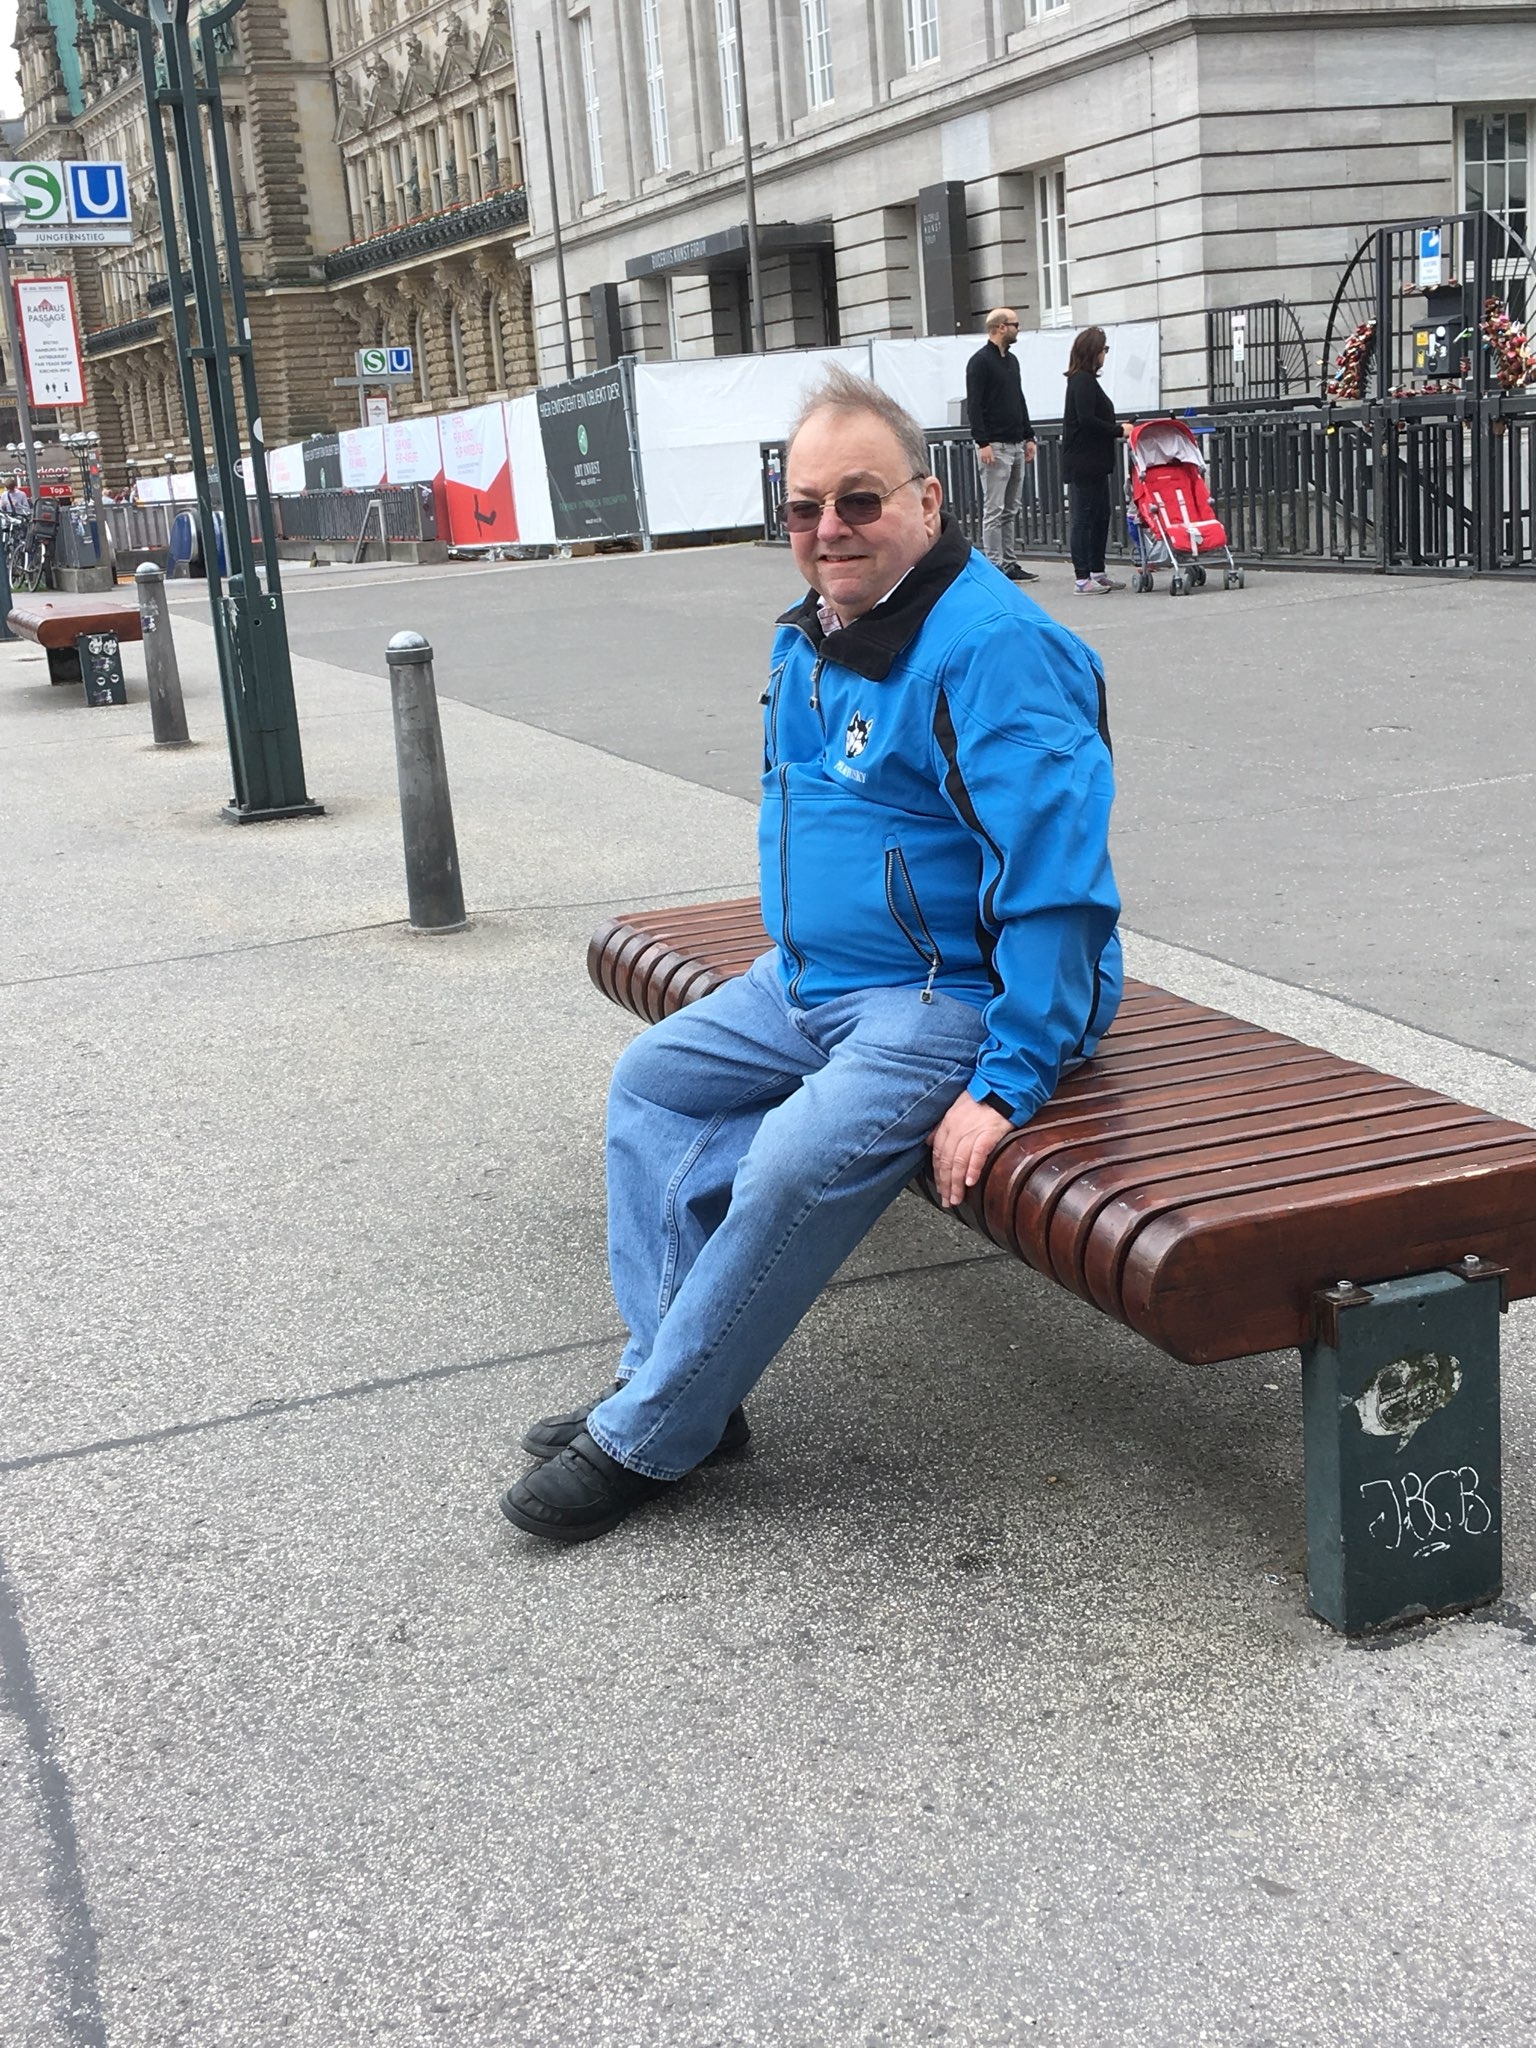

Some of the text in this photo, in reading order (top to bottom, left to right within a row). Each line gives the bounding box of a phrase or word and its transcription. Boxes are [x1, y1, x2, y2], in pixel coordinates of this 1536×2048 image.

[11, 166, 119, 219] S U
[35, 233, 106, 242] JUNGFERNSTIEG
[27, 304, 66, 313] RATHAUS
[28, 313, 66, 322] PASSAGE
[366, 350, 409, 372] S U
[577, 392, 588, 409] EIN
[586, 385, 607, 407] OBJEKT
[606, 382, 620, 401] DER
[49, 486, 64, 495] Top
[269, 597, 277, 610] 3
